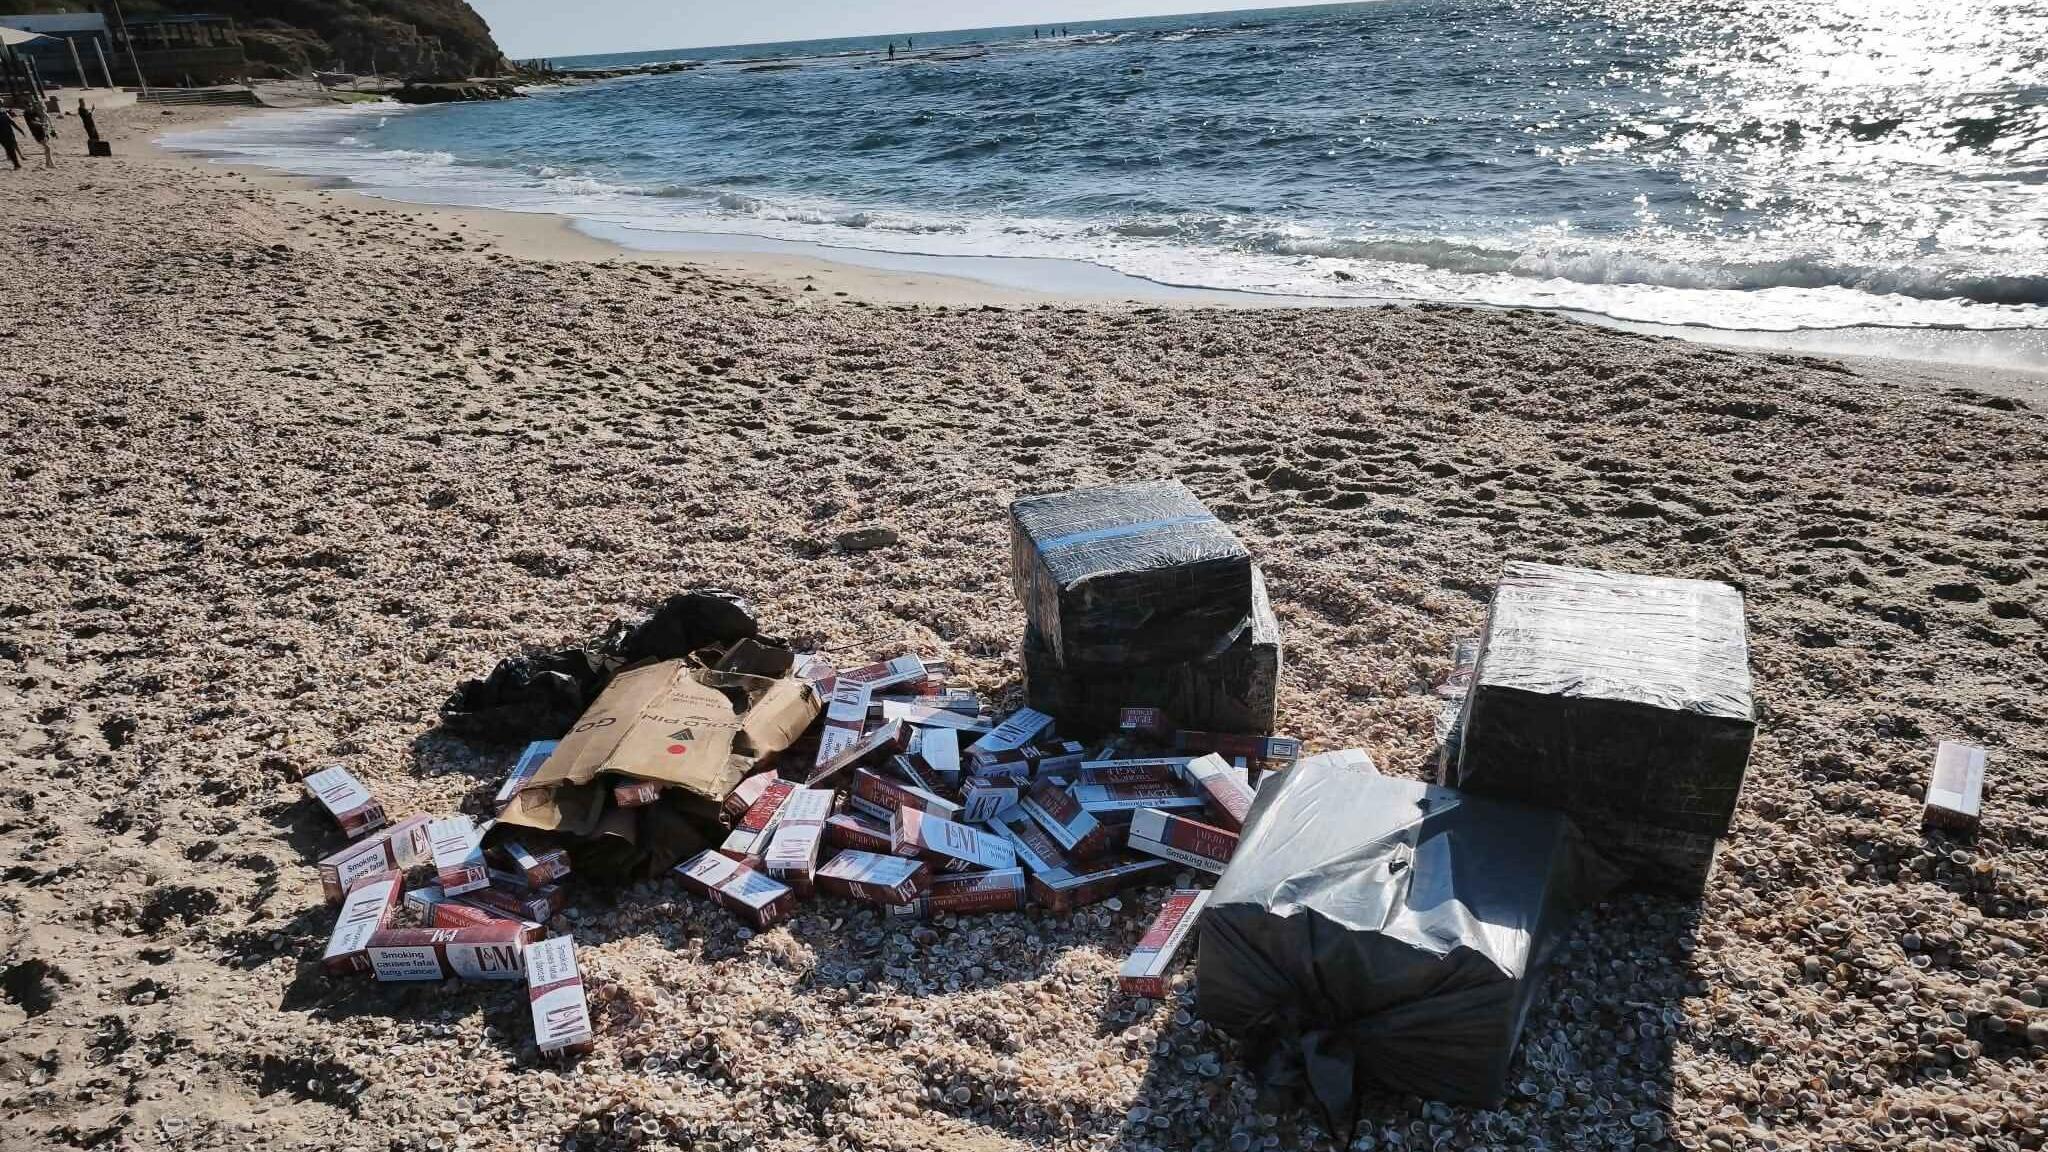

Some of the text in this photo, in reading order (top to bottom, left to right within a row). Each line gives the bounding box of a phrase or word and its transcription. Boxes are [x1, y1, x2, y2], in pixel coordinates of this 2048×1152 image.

[945, 822, 976, 854] L&M
[347, 853, 378, 873] Smoking
[1166, 847, 1204, 867] Smoking
[376, 960, 412, 968] causes
[412, 959, 436, 967] fatal
[381, 951, 424, 961] Smoking
[474, 945, 519, 972] L&M
[379, 968, 437, 977] lung cancer
[546, 1002, 586, 1038] L&M
